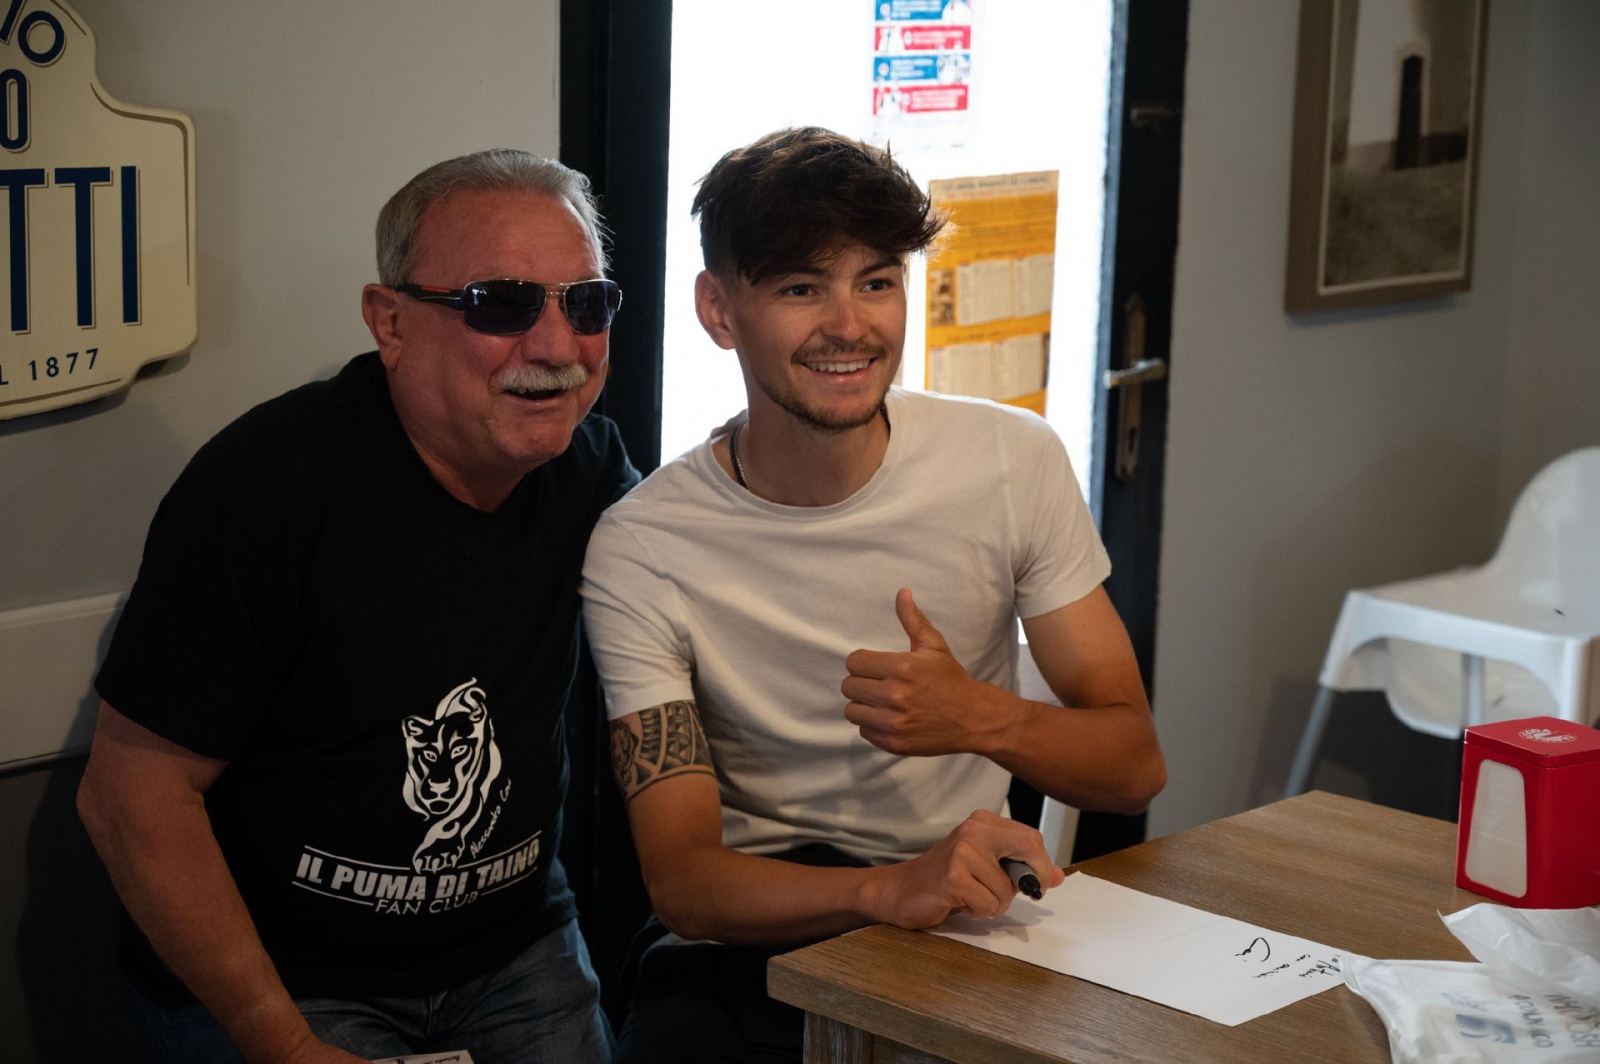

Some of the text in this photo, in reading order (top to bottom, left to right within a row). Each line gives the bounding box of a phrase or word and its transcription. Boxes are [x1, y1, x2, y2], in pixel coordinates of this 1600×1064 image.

[28, 348, 98, 381] 1877
[296, 838, 540, 900] IL PUMA DI TAINO
[375, 891, 479, 915] FAN CLUB
